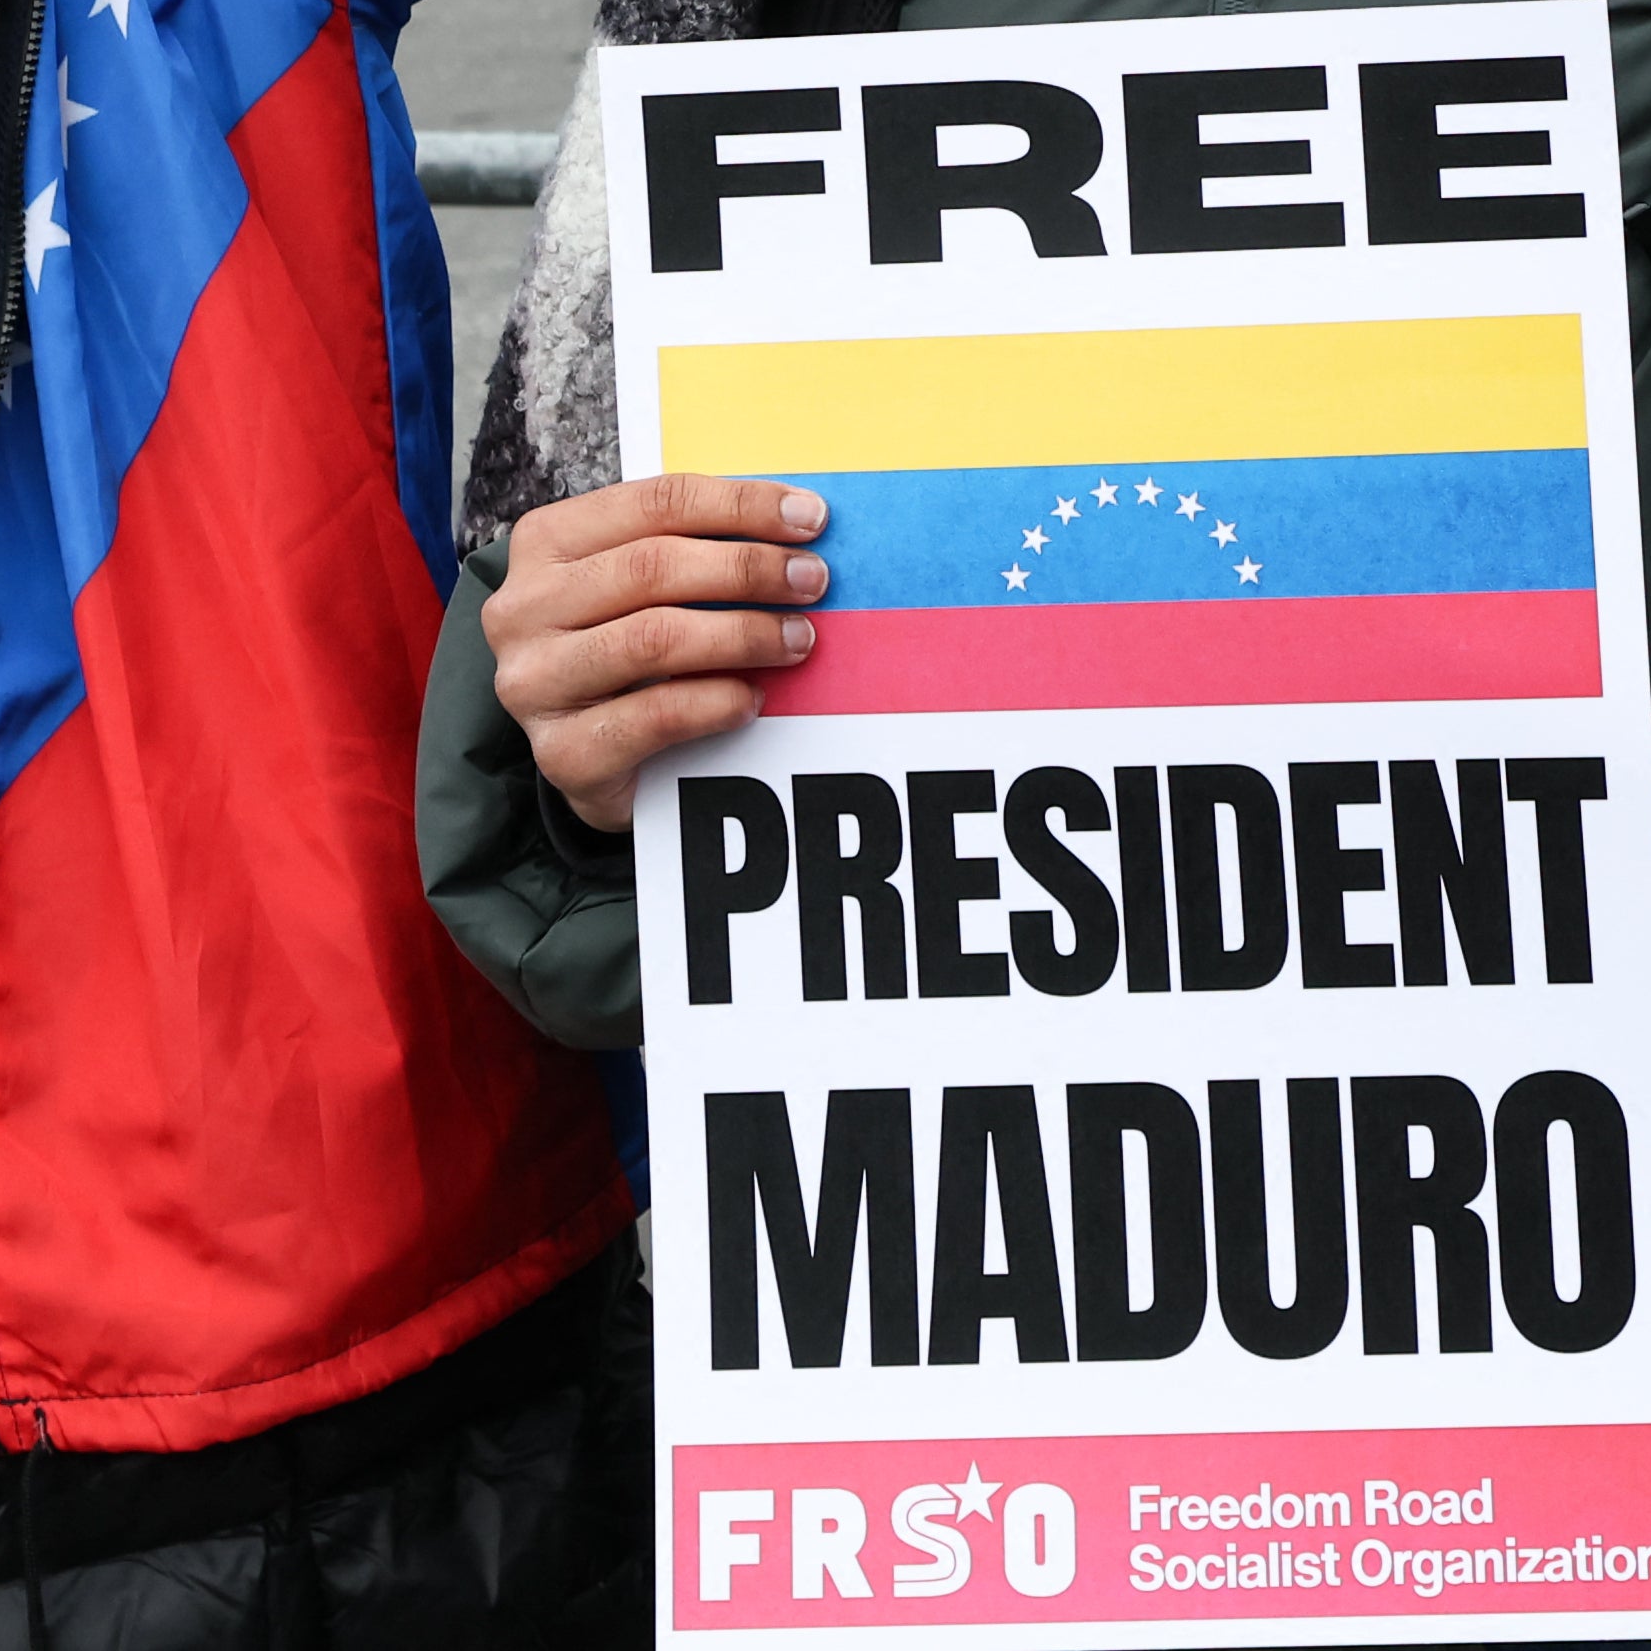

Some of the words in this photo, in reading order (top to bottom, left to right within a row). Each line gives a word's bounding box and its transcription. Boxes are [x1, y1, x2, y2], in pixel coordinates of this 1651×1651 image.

[640, 55, 1588, 273] FREE
[677, 756, 1608, 1006] PRESIDENT
[702, 1070, 1637, 1372] MADURO
[697, 1478, 1077, 1603] FRSO
[1127, 1539, 1343, 1593] Socialist
[1128, 1479, 1351, 1533] Freedom
[1362, 1476, 1495, 1527] Road
